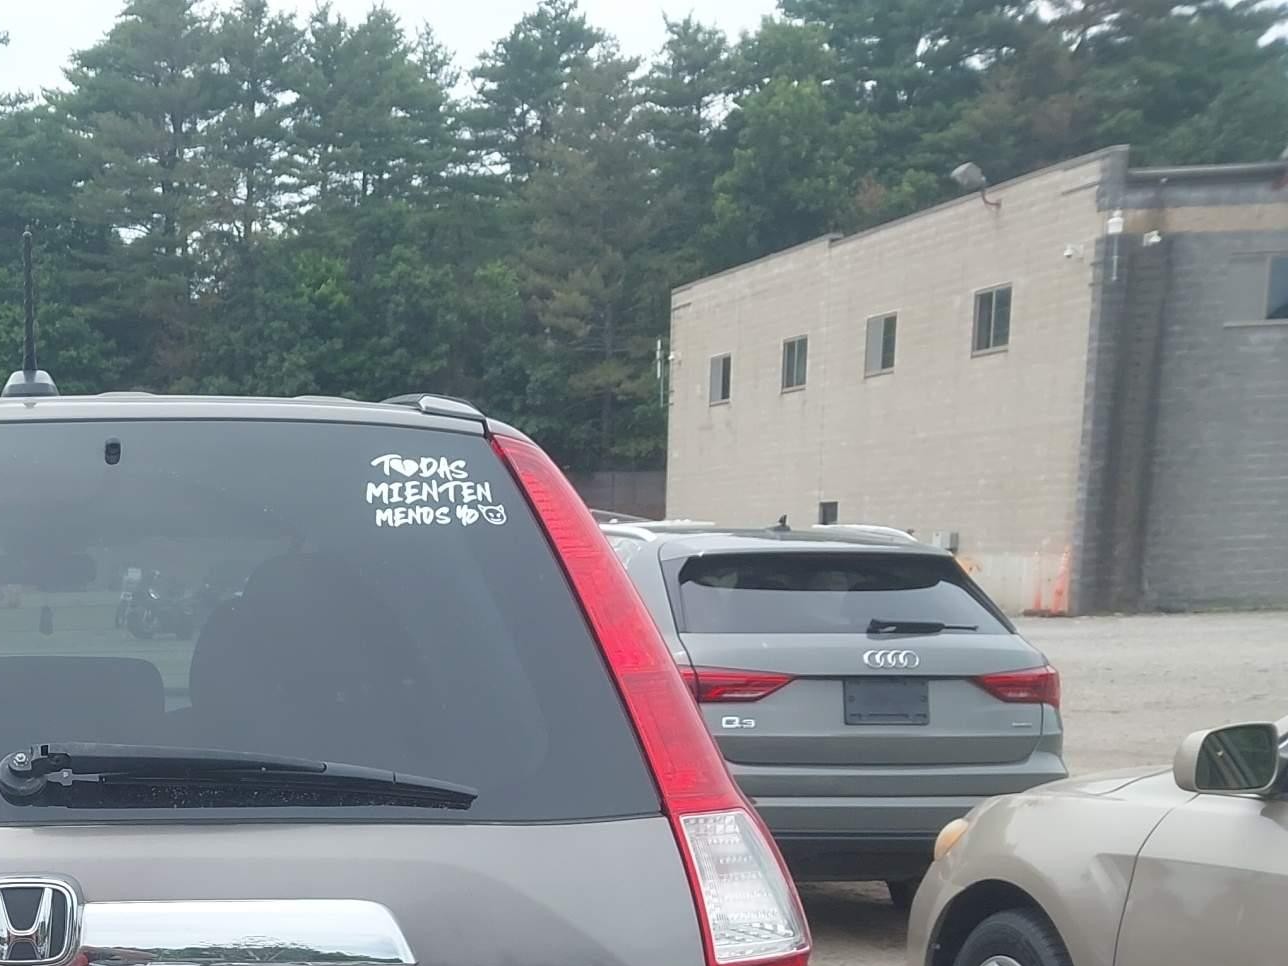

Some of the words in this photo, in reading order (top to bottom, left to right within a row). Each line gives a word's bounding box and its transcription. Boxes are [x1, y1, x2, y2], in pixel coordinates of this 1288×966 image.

[366, 480, 493, 504] MIENTEN
[375, 505, 452, 527] MENOS
[721, 716, 756, 729] Q3
